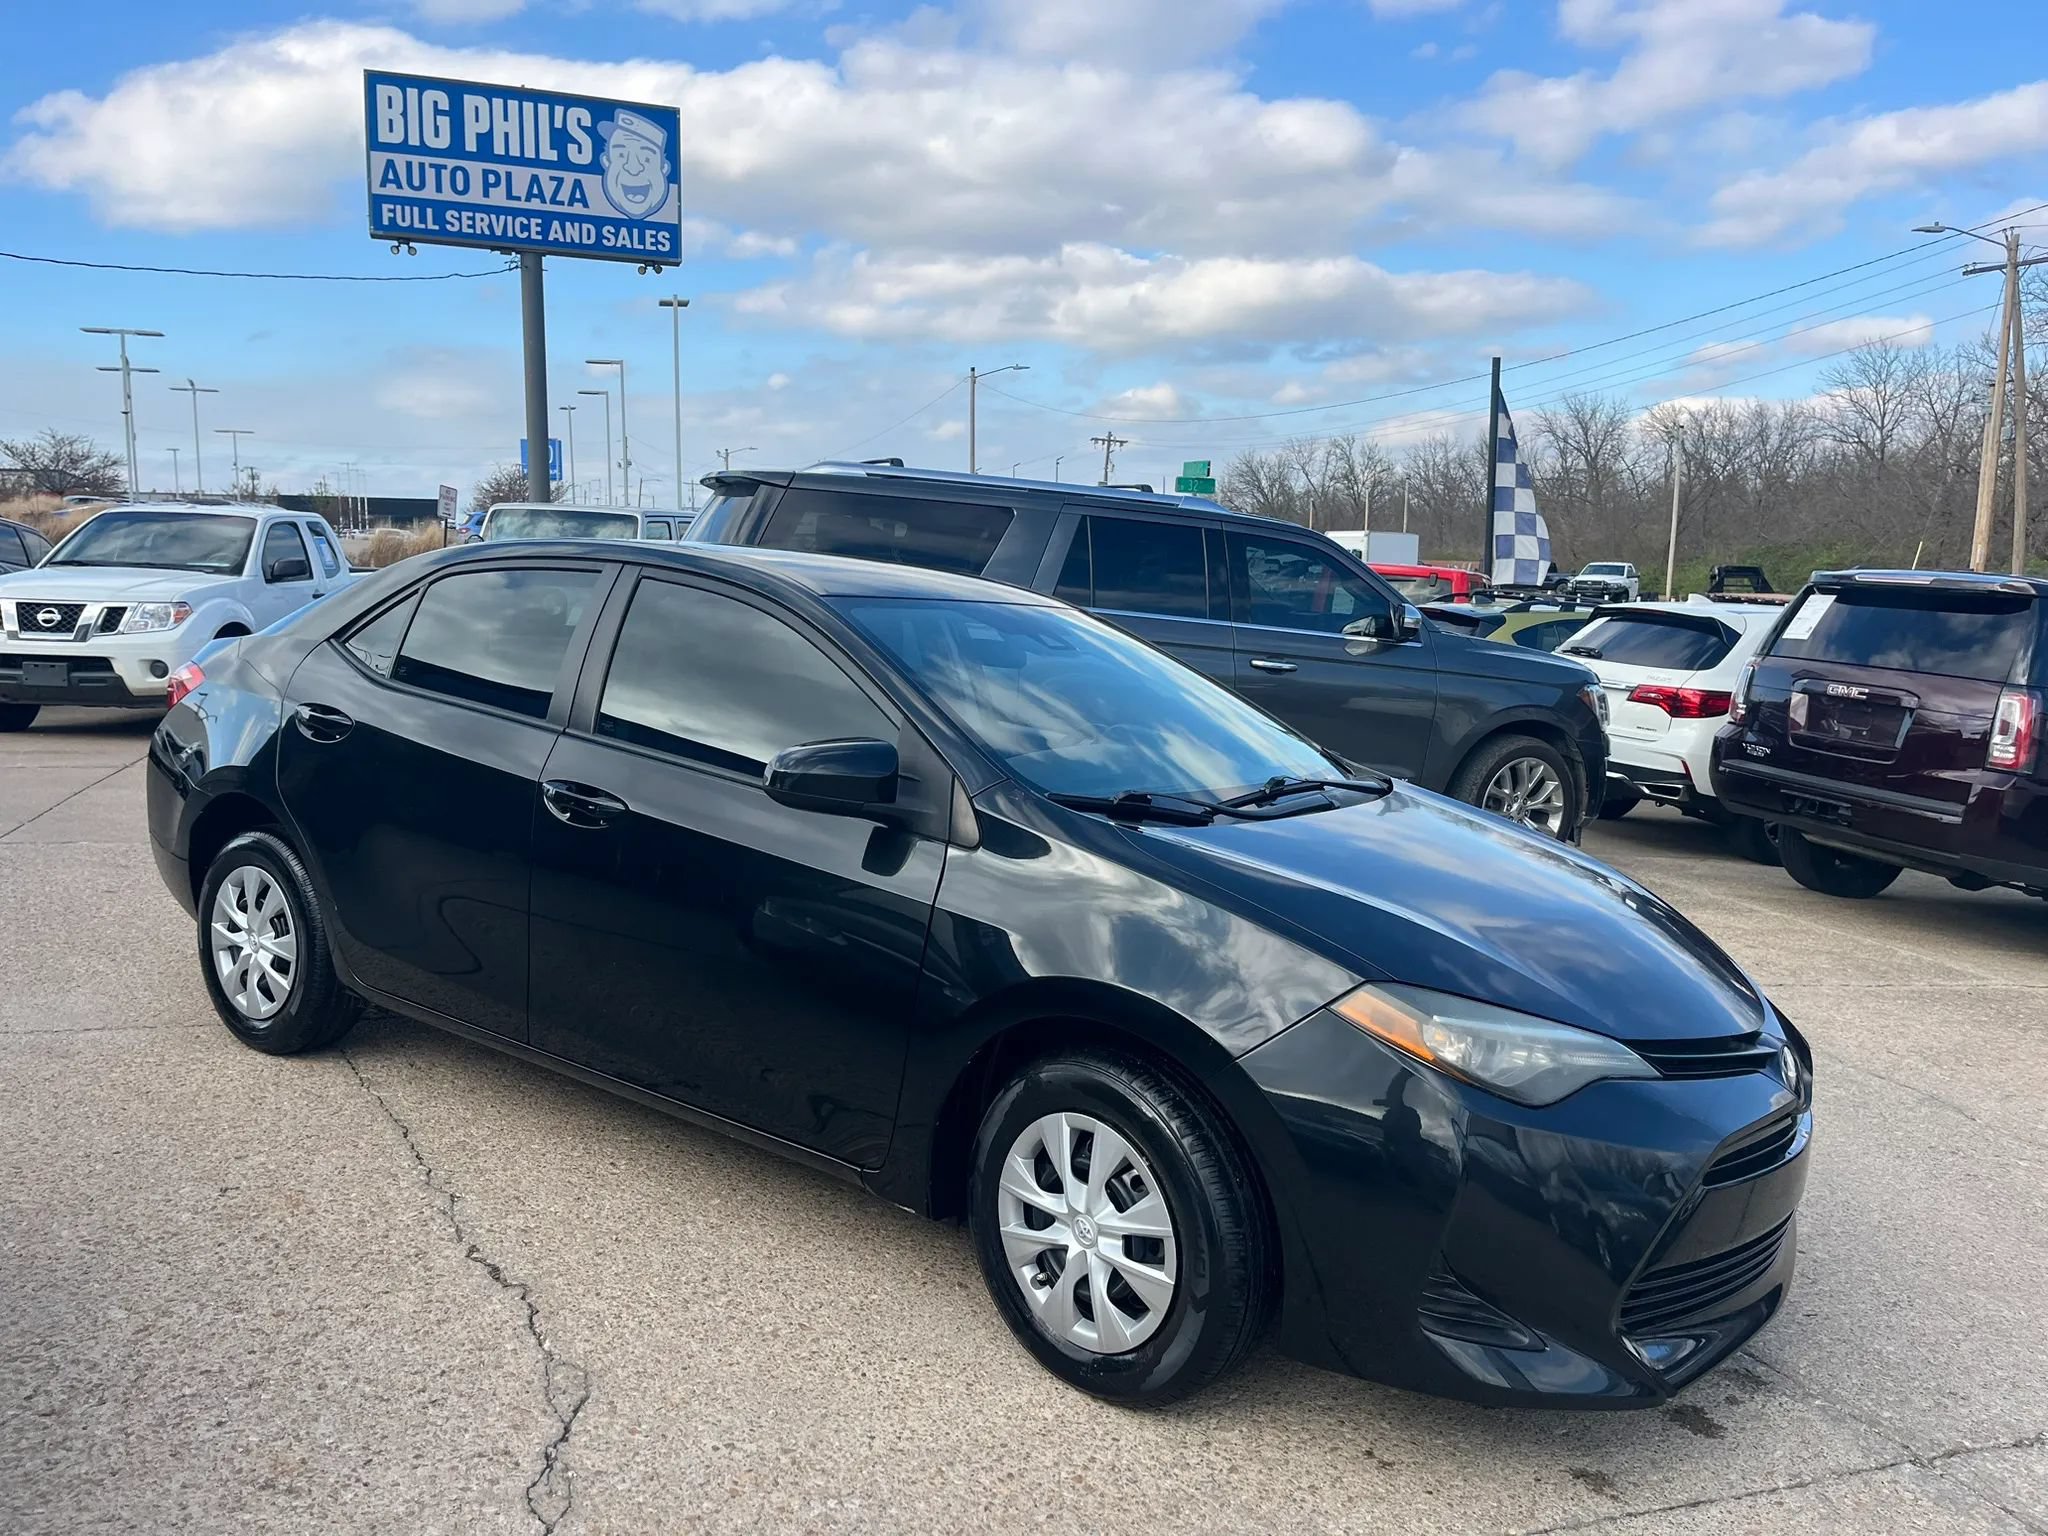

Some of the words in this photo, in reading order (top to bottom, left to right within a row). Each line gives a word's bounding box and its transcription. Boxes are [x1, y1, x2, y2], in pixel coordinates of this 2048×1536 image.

[376, 84, 450, 149] BIG
[463, 94, 593, 165] PHIL'S
[379, 159, 470, 196] AUTO
[482, 169, 590, 209] PLAZA
[381, 203, 439, 231] FULL
[445, 210, 542, 240] SERVICE
[548, 222, 596, 245] AND
[601, 225, 671, 252] SALES
[1827, 683, 1869, 699] GMC
